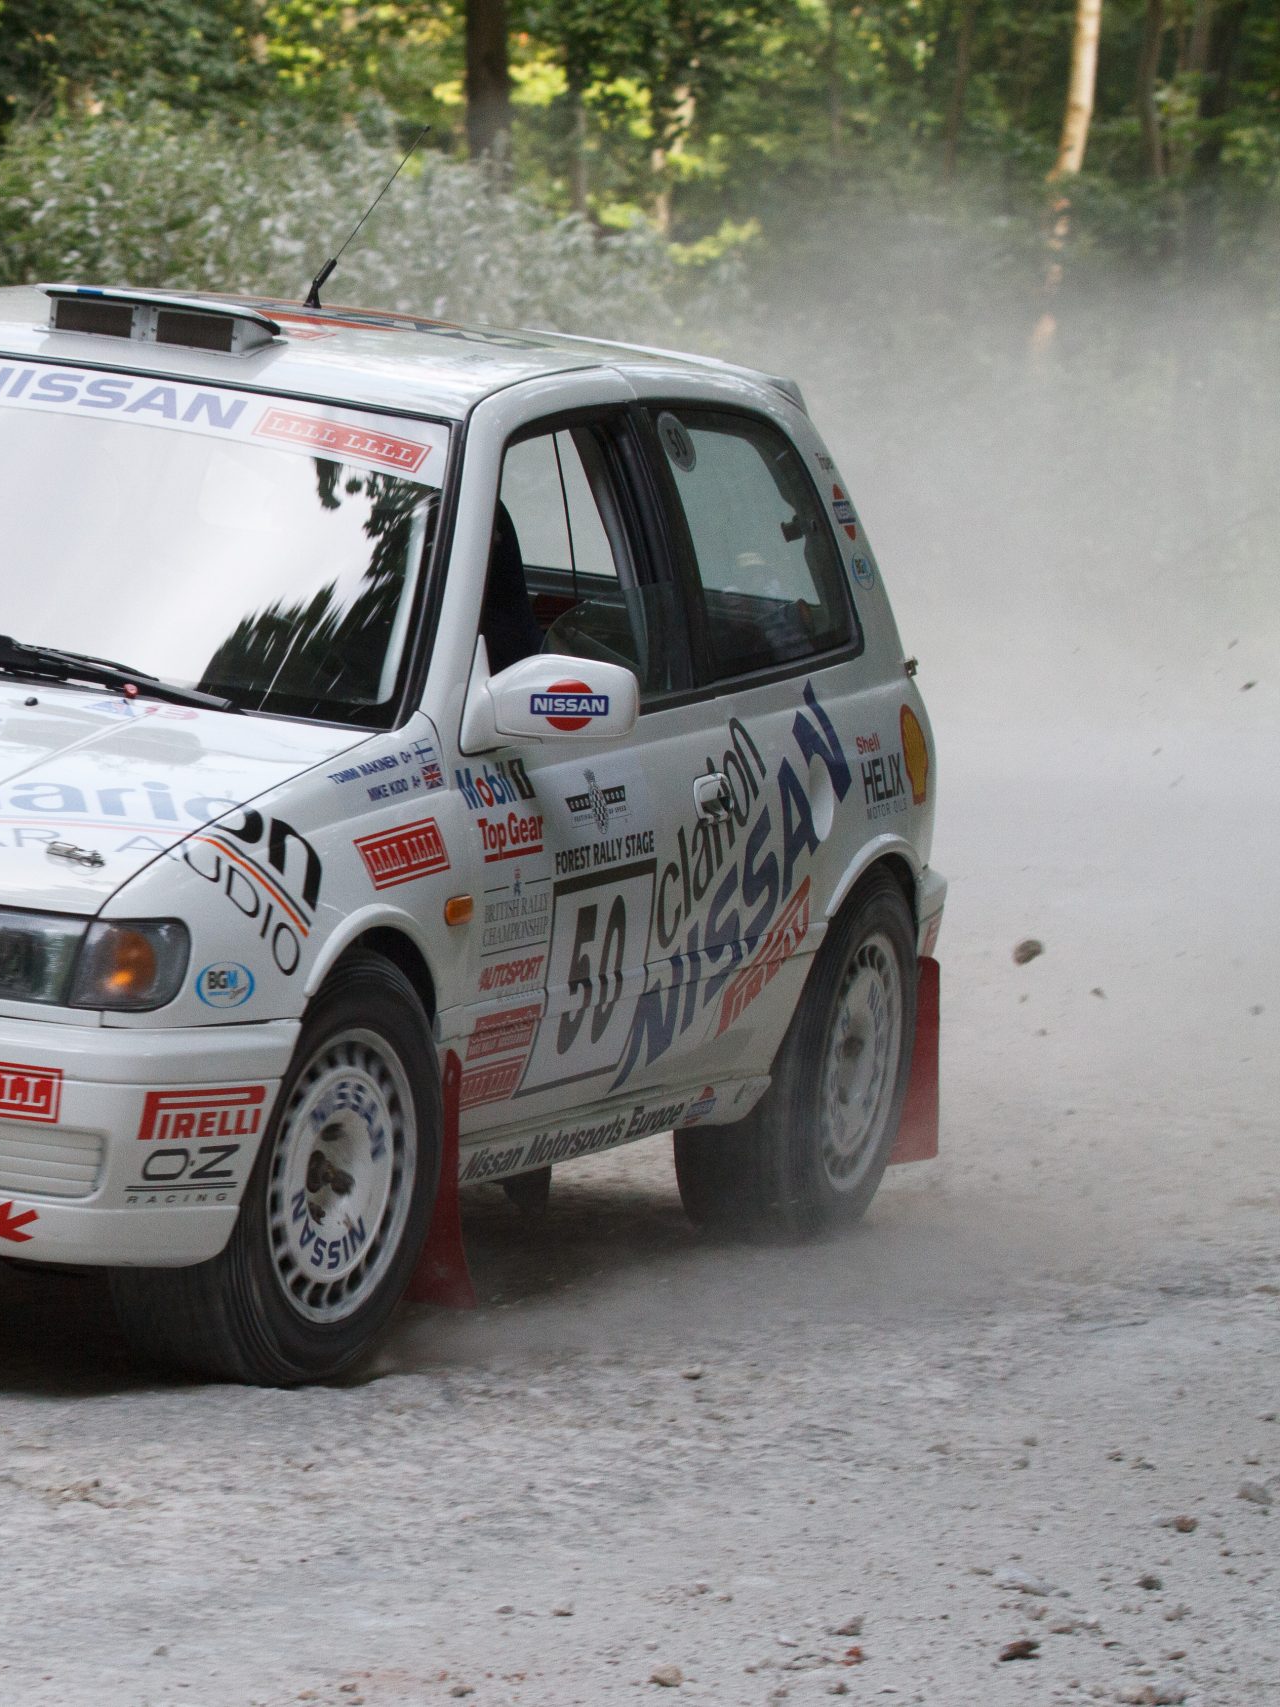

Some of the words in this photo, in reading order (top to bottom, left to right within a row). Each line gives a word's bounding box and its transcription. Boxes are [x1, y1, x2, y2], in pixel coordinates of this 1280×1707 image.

[533, 697, 605, 713] NISSAN
[856, 732, 881, 755] Shell
[455, 761, 518, 810] Mobil
[861, 751, 905, 804] HELIX
[866, 803, 892, 821] MOTOR
[554, 848, 591, 875] FOREST
[593, 838, 623, 865] RALLY
[625, 830, 655, 857] STAGE
[113, 834, 301, 976] AUDIO
[484, 898, 522, 924] BRITISH
[519, 892, 550, 917] RALLY
[606, 677, 853, 1093] NISSAN
[482, 916, 549, 947] CHAMPIONSHIP
[479, 955, 545, 992] AUTOSPORT
[556, 894, 627, 1056] 50
[137, 1086, 267, 1140] PIRELLI
[458, 1145, 525, 1180] Nissan
[522, 1117, 626, 1167] Motorsports
[626, 1099, 685, 1137] Europe
[126, 1193, 228, 1204] RACING
[291, 1188, 367, 1270] NISSAN
